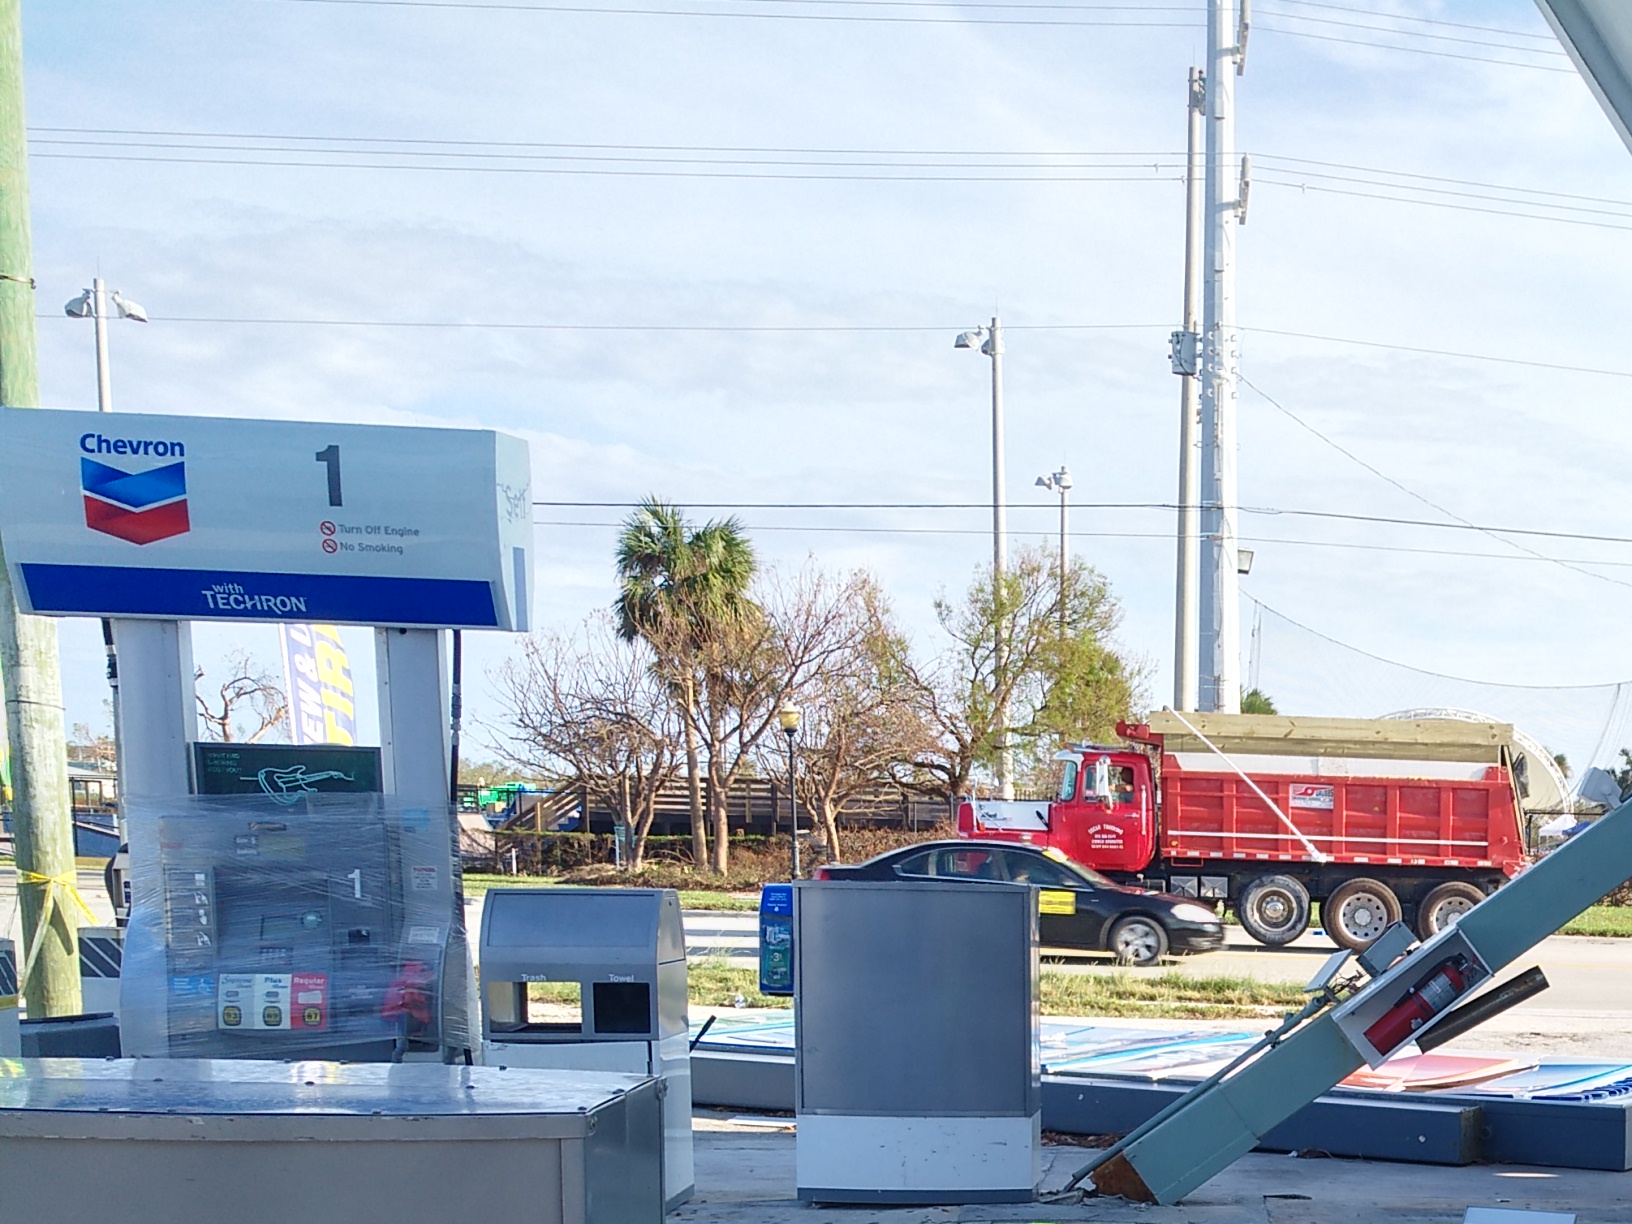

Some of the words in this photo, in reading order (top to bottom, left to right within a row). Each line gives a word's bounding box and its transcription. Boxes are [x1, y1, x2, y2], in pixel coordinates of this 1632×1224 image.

[80, 433, 185, 457] Chevron
[315, 445, 343, 507] 1
[339, 524, 362, 535] Turn
[366, 525, 381, 535] Off
[384, 525, 420, 537] Engine
[340, 542, 355, 552] No
[358, 542, 404, 555] Smoking
[211, 583, 244, 594] with
[201, 590, 307, 614] TECHRON
[297, 677, 324, 744] EW
[347, 869, 362, 898] 1
[293, 977, 325, 985] Regular
[608, 974, 635, 982] Towel
